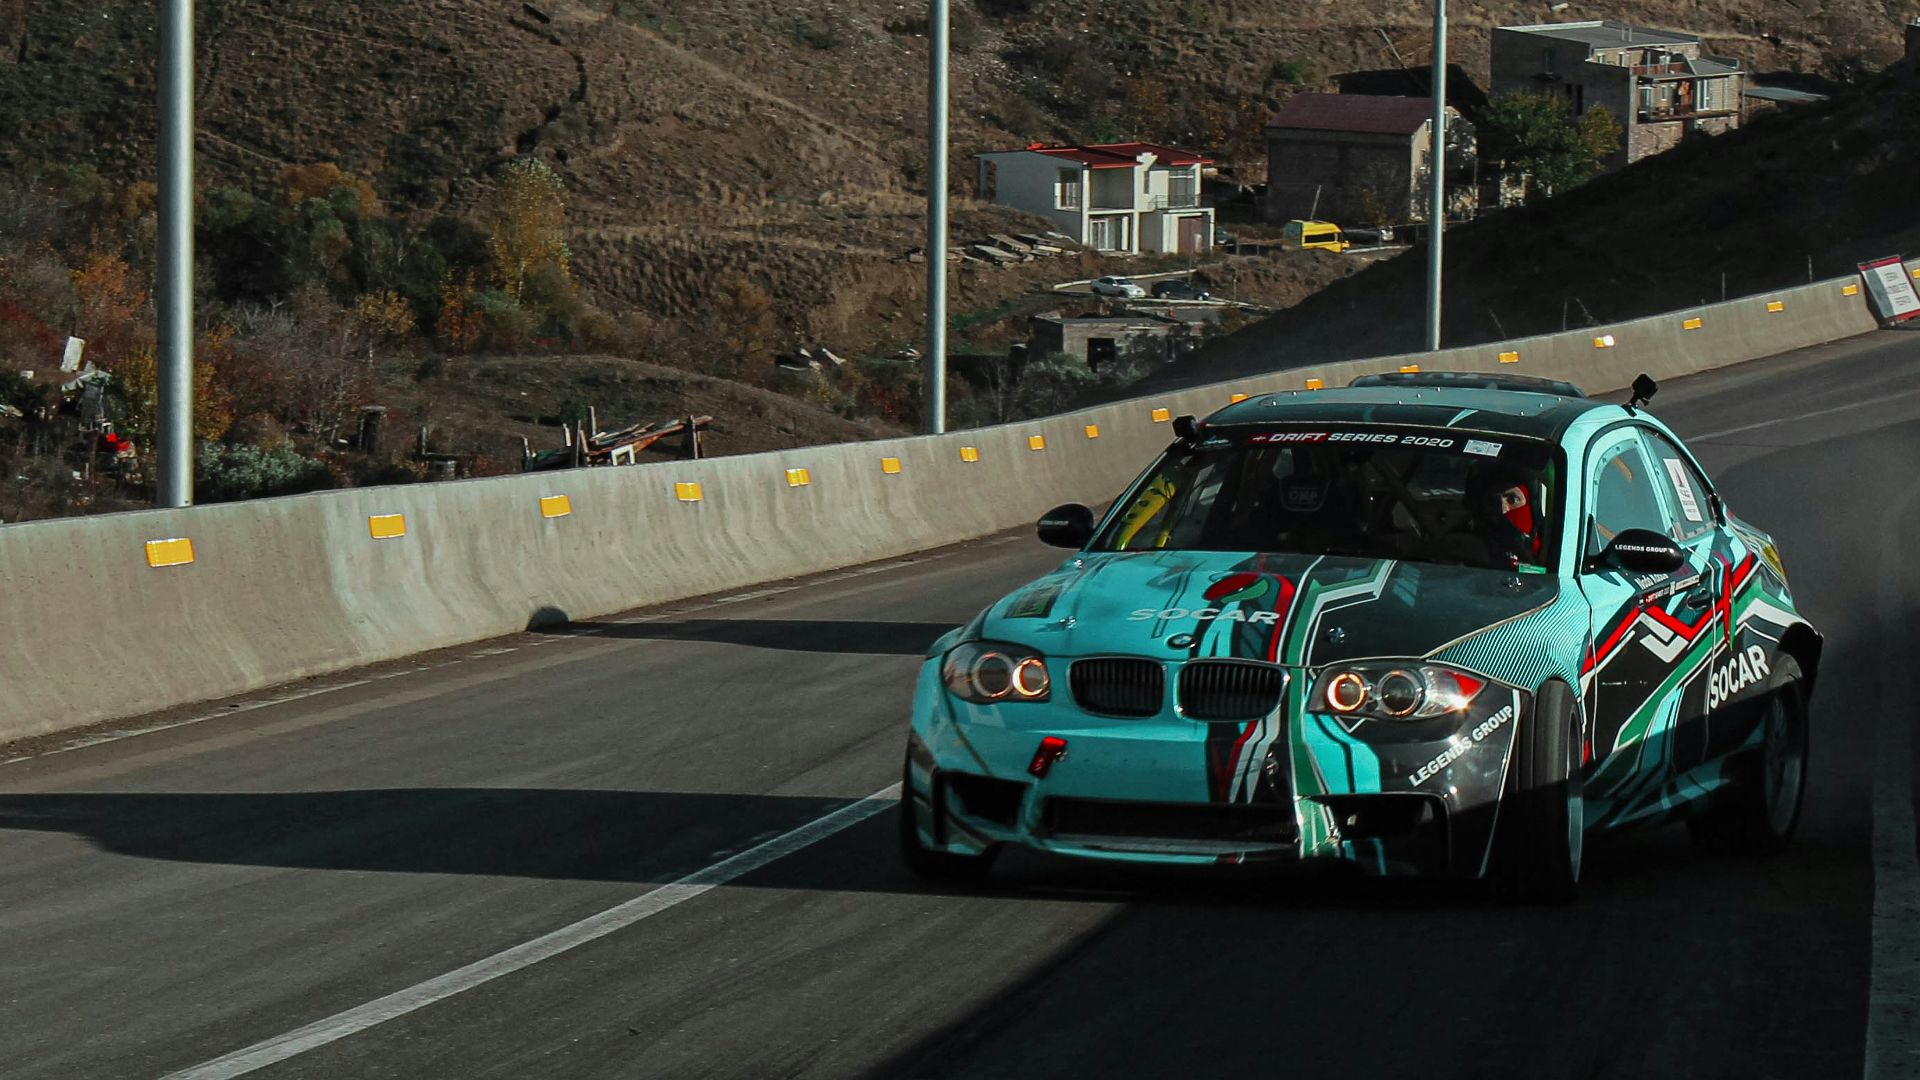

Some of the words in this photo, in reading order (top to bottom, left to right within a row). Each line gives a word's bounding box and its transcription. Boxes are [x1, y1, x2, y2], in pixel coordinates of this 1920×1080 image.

[1268, 433, 1327, 442] DRIFT
[1327, 433, 1399, 443] SERIES
[1400, 436, 1454, 448] 2020
[1614, 544, 1645, 552] LEGENDS
[1126, 608, 1281, 625] SOCAR
[1710, 644, 1771, 709] SOCAR
[1408, 736, 1473, 787] LEGENDS
[1471, 705, 1513, 741] GROUP
